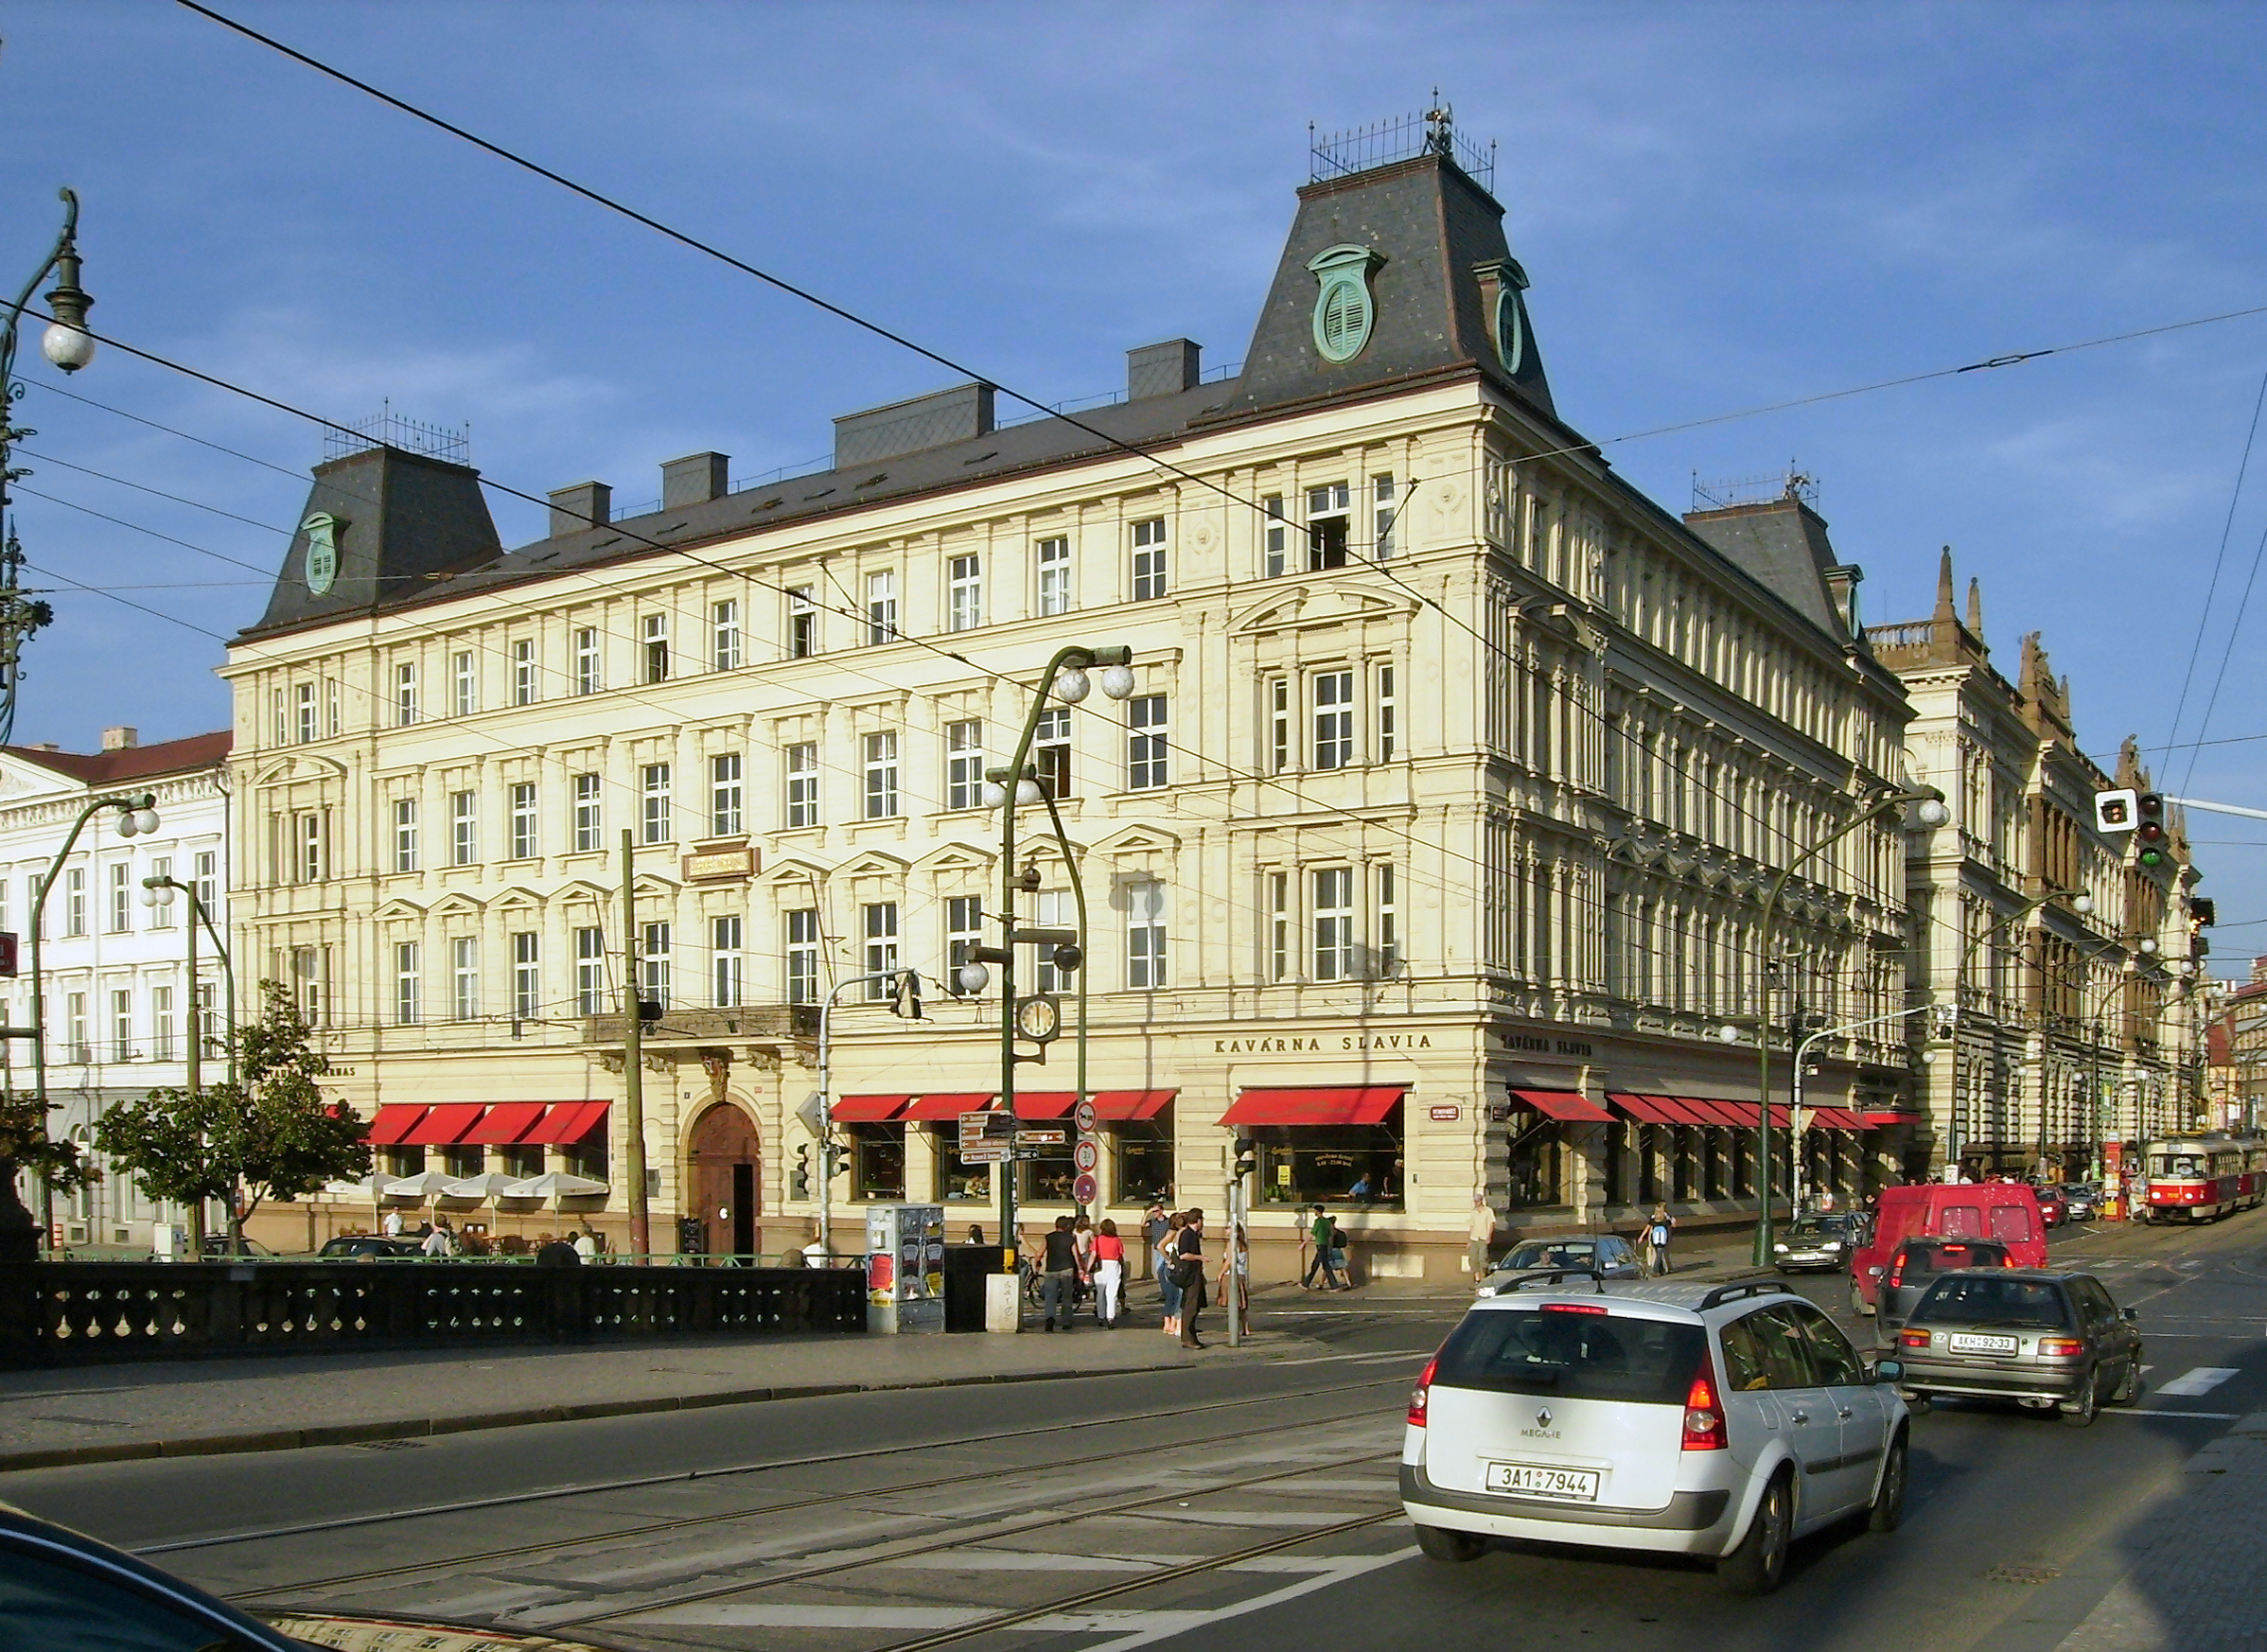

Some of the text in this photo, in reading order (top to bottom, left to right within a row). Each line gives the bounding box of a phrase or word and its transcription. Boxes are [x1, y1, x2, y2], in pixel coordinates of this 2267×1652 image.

[1214, 1034, 1432, 1053] KAVÁRNA SLAVIA
[1959, 1336, 2011, 1348] AKH 92-33
[1520, 1429, 1561, 1439] MEGANE
[1502, 1467, 1587, 1493] 3A1 7944
